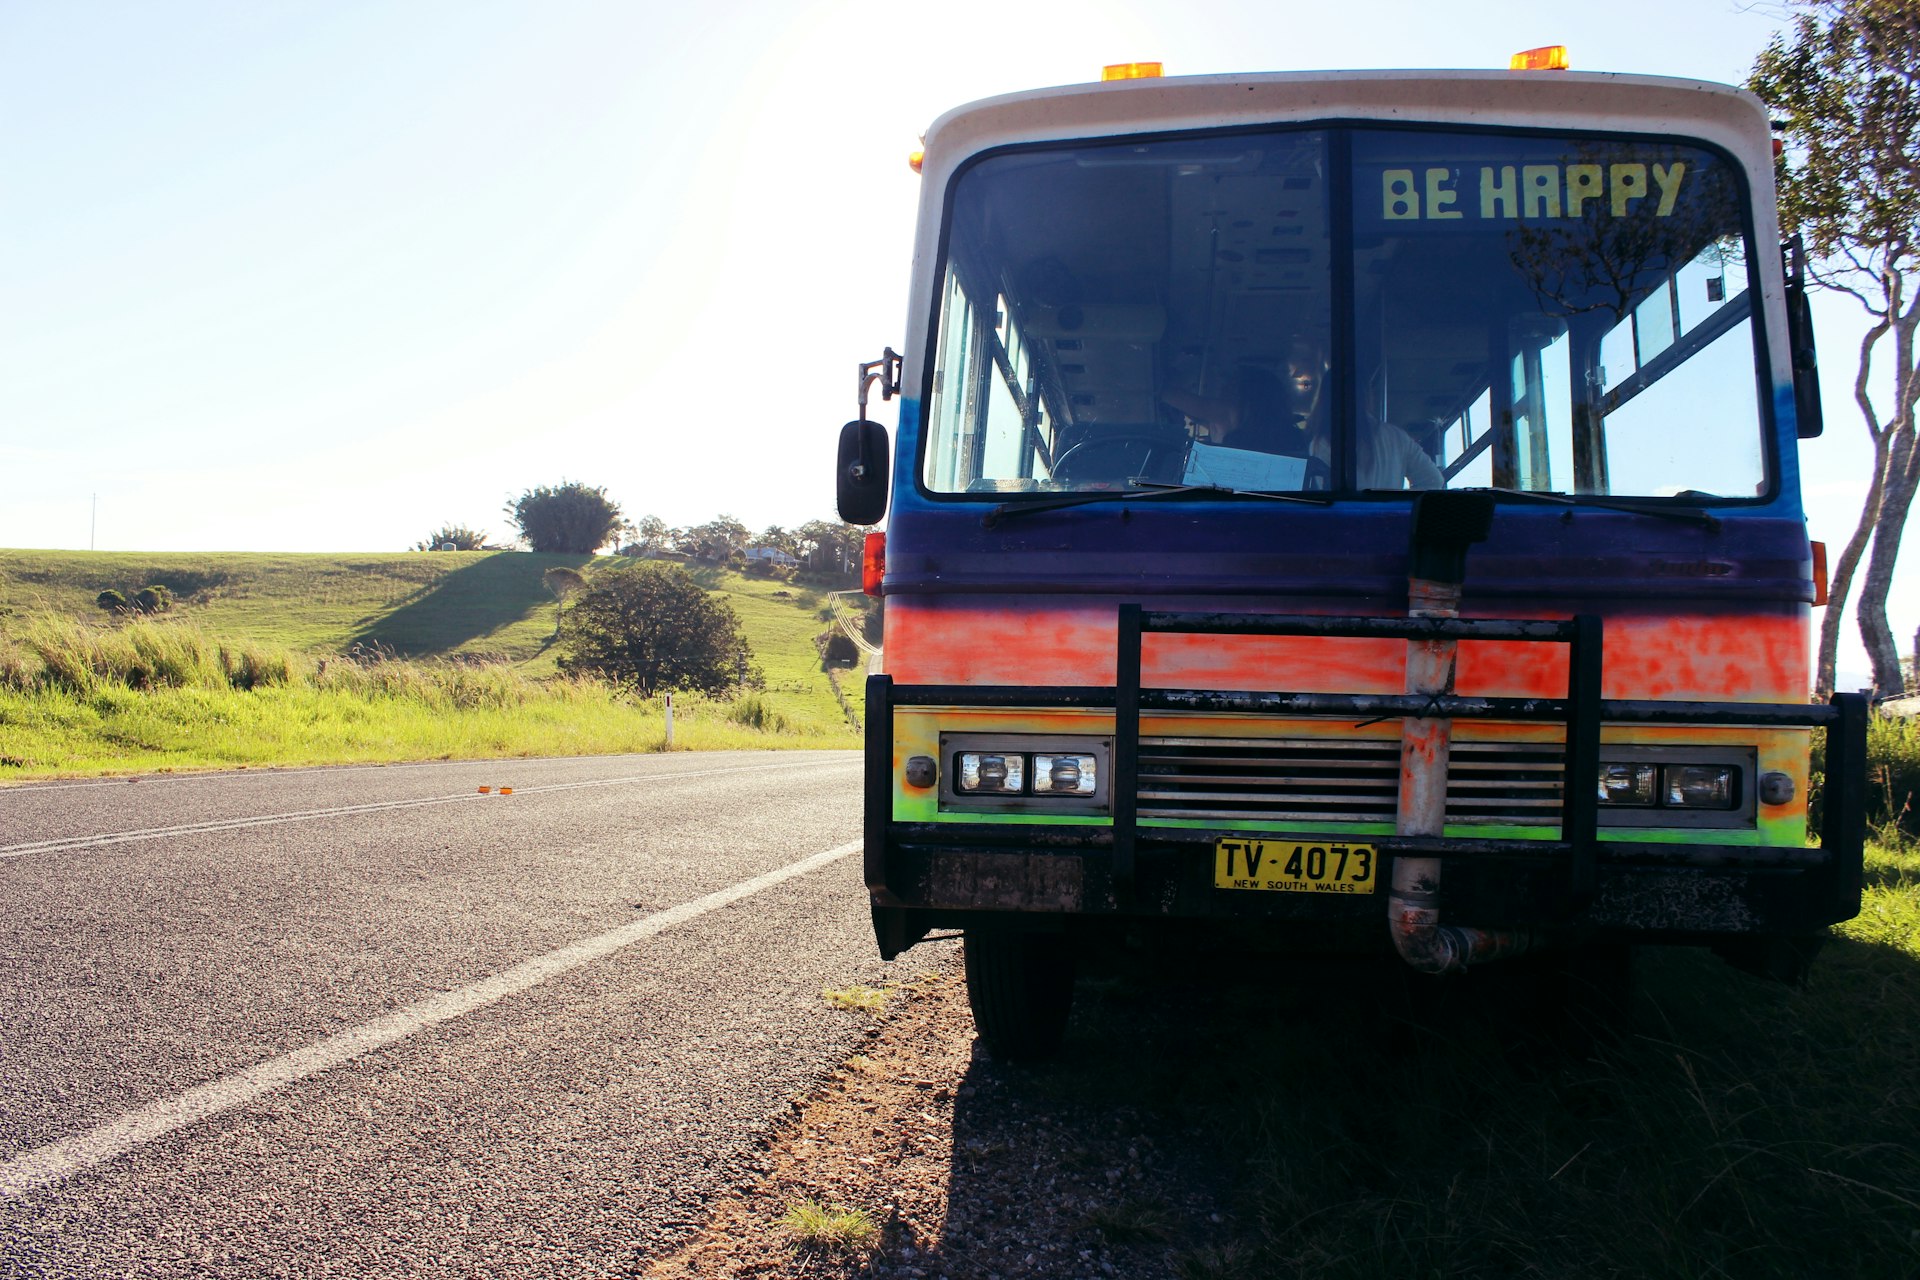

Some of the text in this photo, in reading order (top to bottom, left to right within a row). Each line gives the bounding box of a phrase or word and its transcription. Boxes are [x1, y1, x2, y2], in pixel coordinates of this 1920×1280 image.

[1383, 162, 1686, 220] BE HAPPY
[1233, 879, 1355, 892] NEW SOUTH WALES
